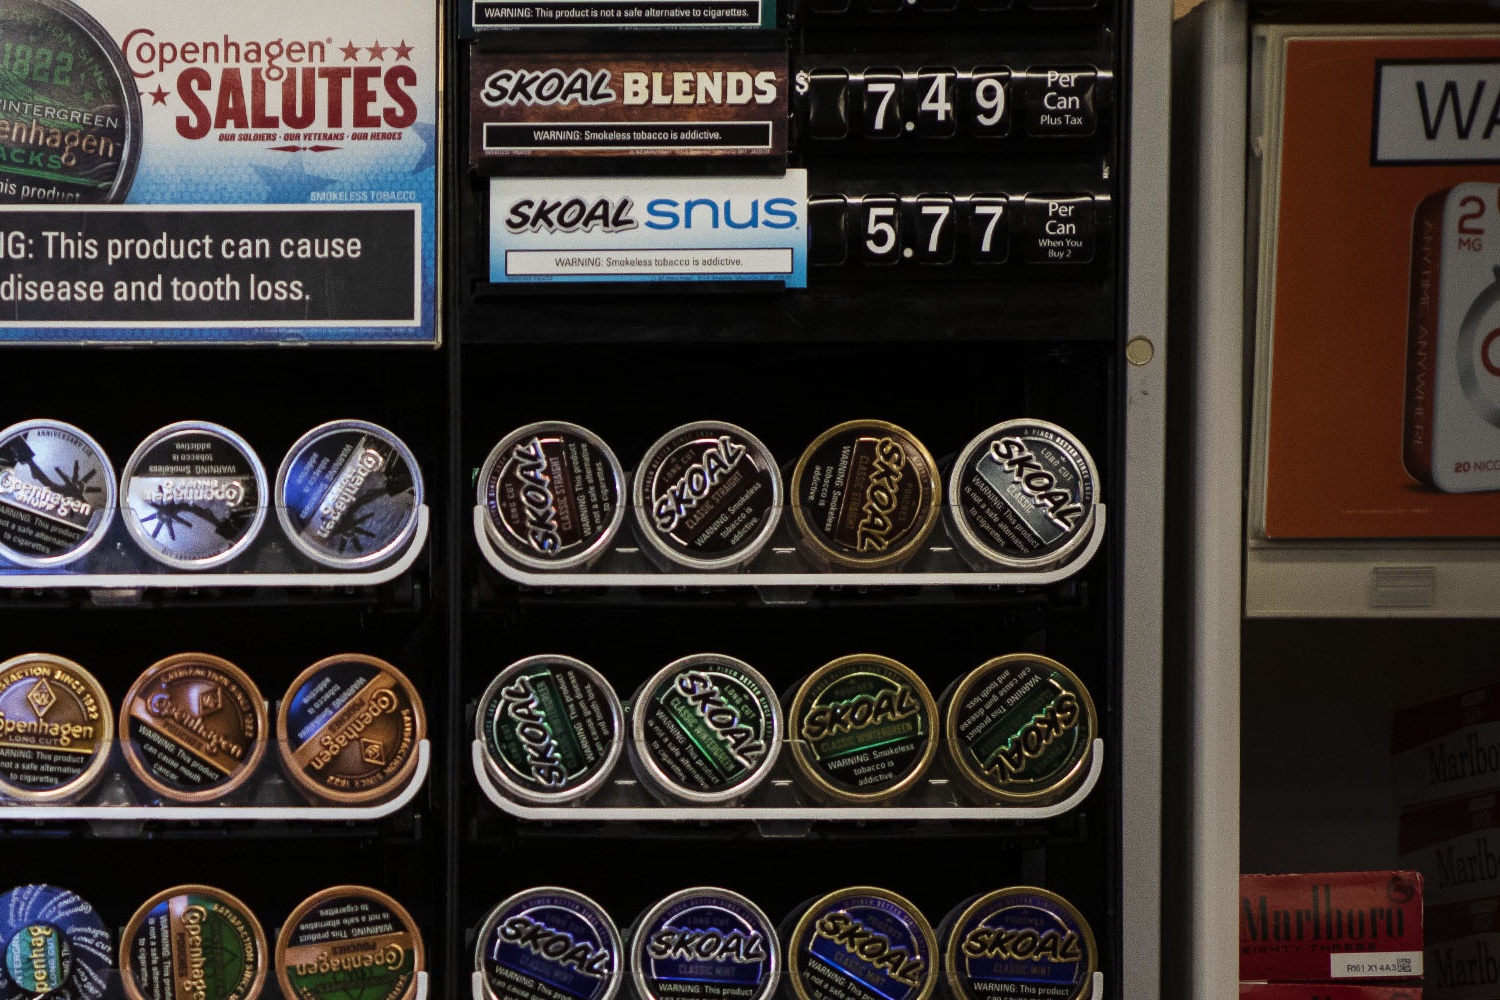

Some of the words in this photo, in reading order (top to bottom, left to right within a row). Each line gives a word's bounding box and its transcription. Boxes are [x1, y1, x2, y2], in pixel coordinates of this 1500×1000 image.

[4, 42, 73, 86] 1822
[122, 28, 326, 81] Copenhagen
[481, 68, 616, 107] SKOAL
[622, 71, 777, 105] BLENDS
[1048, 71, 1078, 88] Per
[176, 65, 417, 140] SALUTES
[1044, 92, 1080, 110] Can
[219, 133, 235, 141] OUR
[238, 133, 277, 141] SOLDIERS
[284, 133, 301, 141] OUR
[303, 133, 344, 141] VETERANS
[351, 132, 368, 140] OUR
[370, 132, 402, 140] HEROES
[533, 130, 582, 141] WARNING:
[584, 130, 631, 141] Smokeless
[633, 130, 669, 140] tobacco
[670, 130, 678, 140] is
[680, 129, 722, 140] addictive.
[1041, 115, 1061, 125] Plus
[1064, 115, 1083, 125] Tax
[311, 192, 368, 201] SMOKELESS
[370, 191, 415, 200] TOBACCO
[1048, 202, 1075, 216] Per
[503, 196, 639, 234] SKOAL
[644, 197, 798, 230] snus
[866, 205, 1003, 258] 5.77
[1045, 221, 1076, 235] Can
[1458, 196, 1486, 235] 2
[43, 232, 98, 260] This
[107, 233, 213, 265] product
[221, 236, 270, 259] can
[280, 236, 362, 258] cause
[1038, 239, 1064, 247] When
[1066, 239, 1083, 248] You
[1048, 249, 1064, 259] Buy
[1066, 250, 1072, 258] 2
[1458, 238, 1483, 252] MG
[0, 276, 105, 302] disease
[113, 276, 162, 302] and
[171, 275, 241, 302] tooth
[250, 275, 311, 301] loss.
[657, 436, 746, 534] SKOAL
[804, 686, 921, 737] SKOAL
[1240, 885, 1405, 942] Marlboro
[650, 927, 767, 963] SKOAL
[962, 925, 1082, 962] SKOAL
